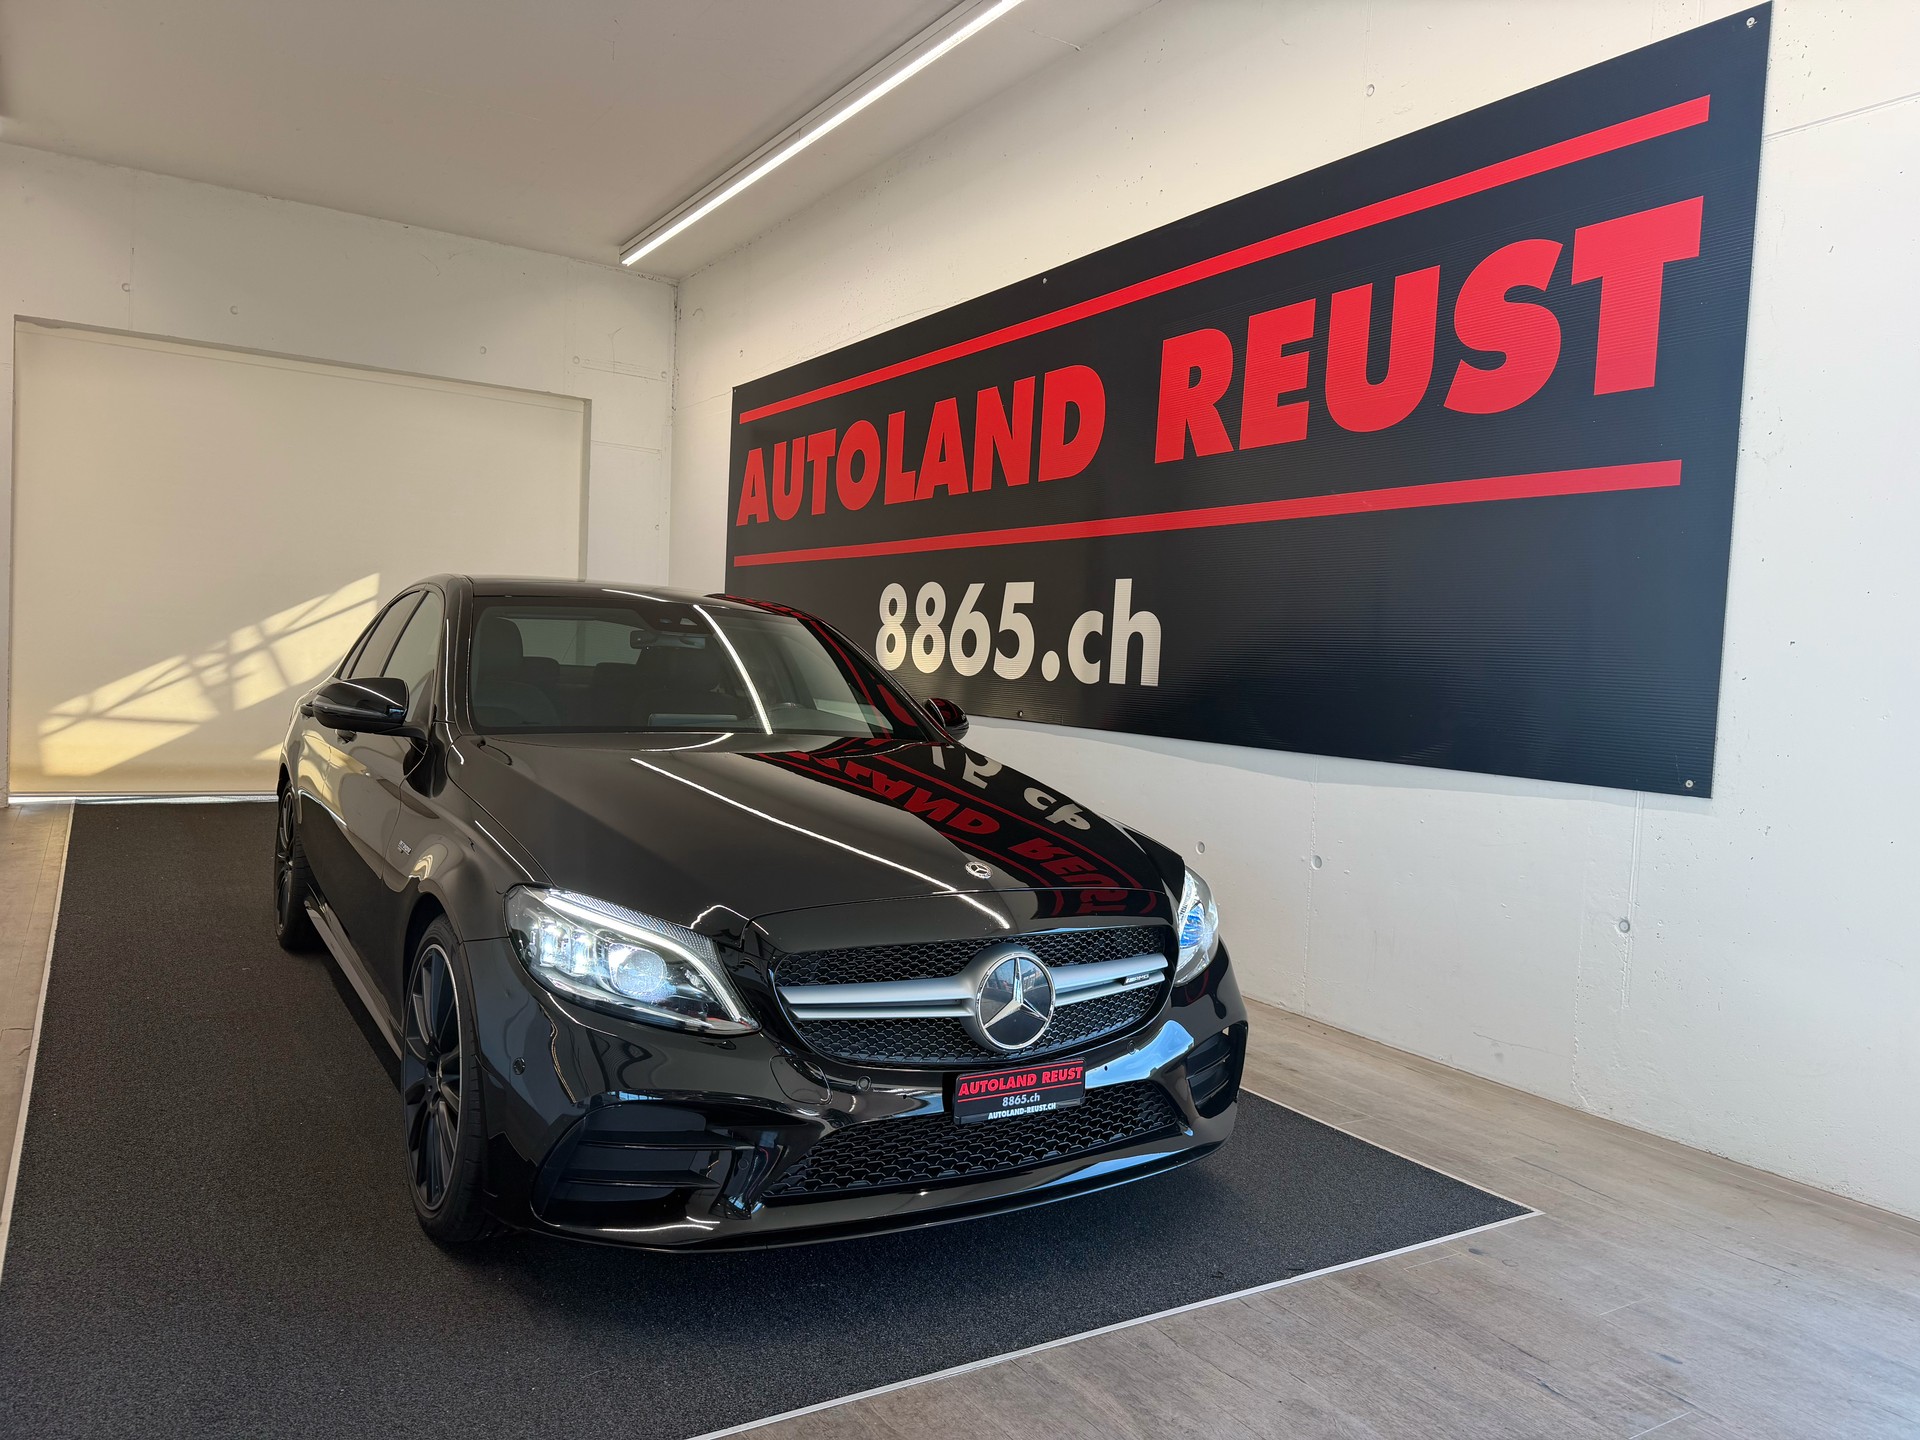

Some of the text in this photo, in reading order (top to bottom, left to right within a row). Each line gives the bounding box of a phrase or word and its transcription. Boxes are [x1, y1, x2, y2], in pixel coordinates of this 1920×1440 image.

[737, 196, 1704, 526] AUTOLAND REUST
[876, 579, 1161, 686] 8865.ch
[958, 1066, 1084, 1097] AUTOLAND REUST
[987, 1102, 1057, 1120] AUTOLAND-REUST.CH
[1002, 1092, 1041, 1107] 8865.ch
